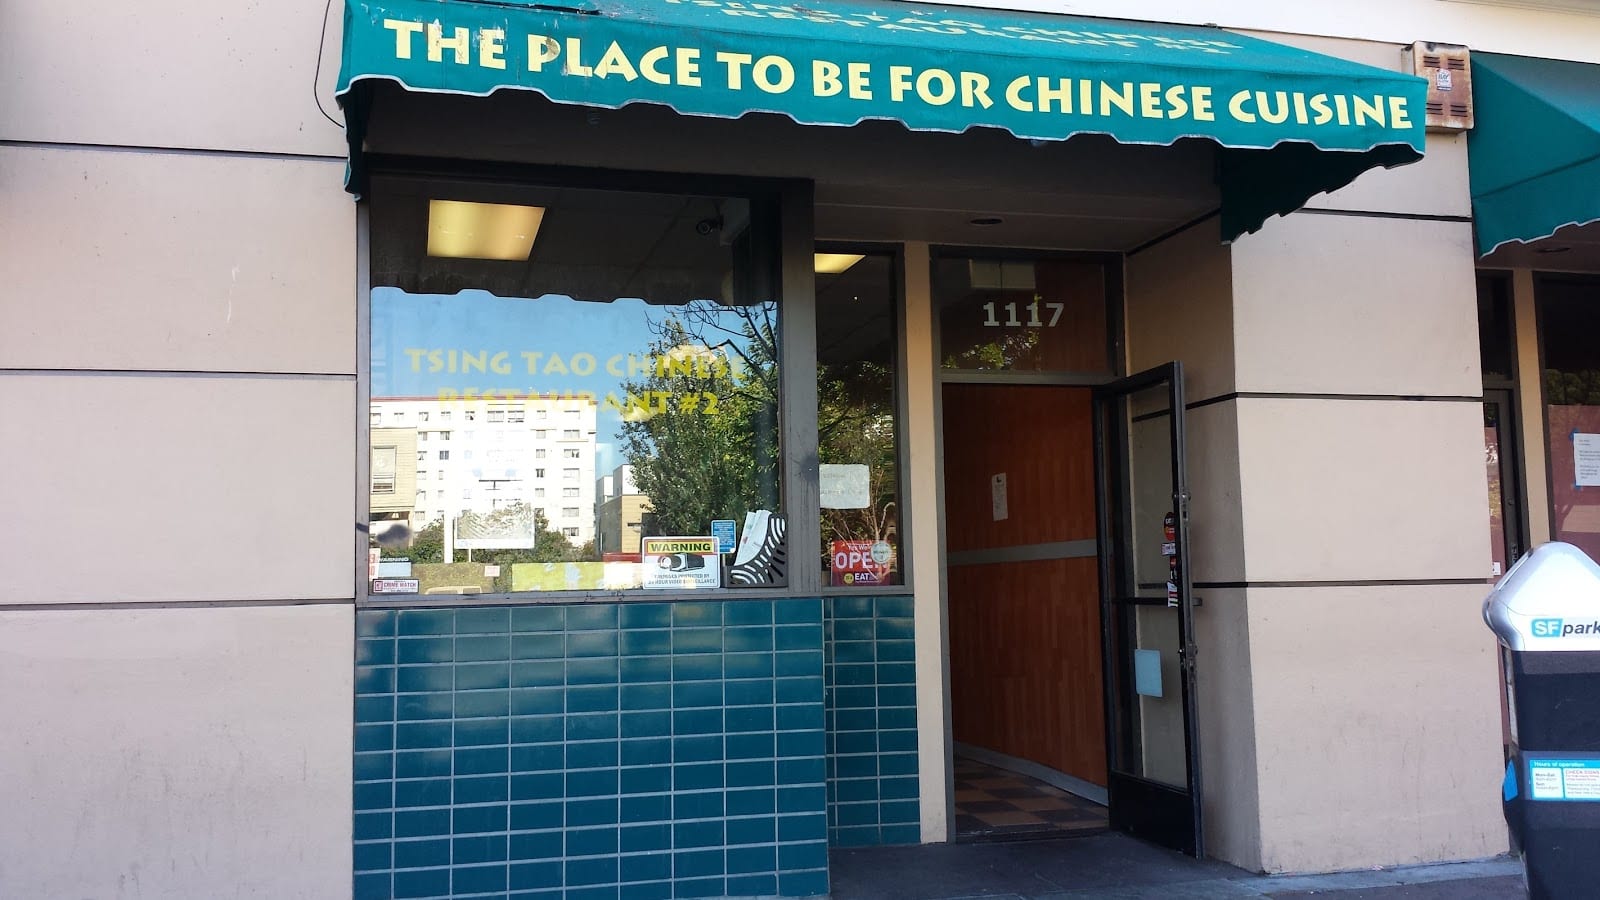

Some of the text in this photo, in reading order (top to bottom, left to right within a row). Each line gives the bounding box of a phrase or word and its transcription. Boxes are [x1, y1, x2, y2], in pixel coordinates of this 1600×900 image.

[384, 18, 1413, 130] THE PLACE TO BE FOR CHINESE CUISINE
[982, 301, 1065, 327] 1117
[404, 348, 746, 380] TSING TAO CHINESE
[437, 386, 720, 415] RESTAURANT #2
[651, 543, 711, 552] WARNING
